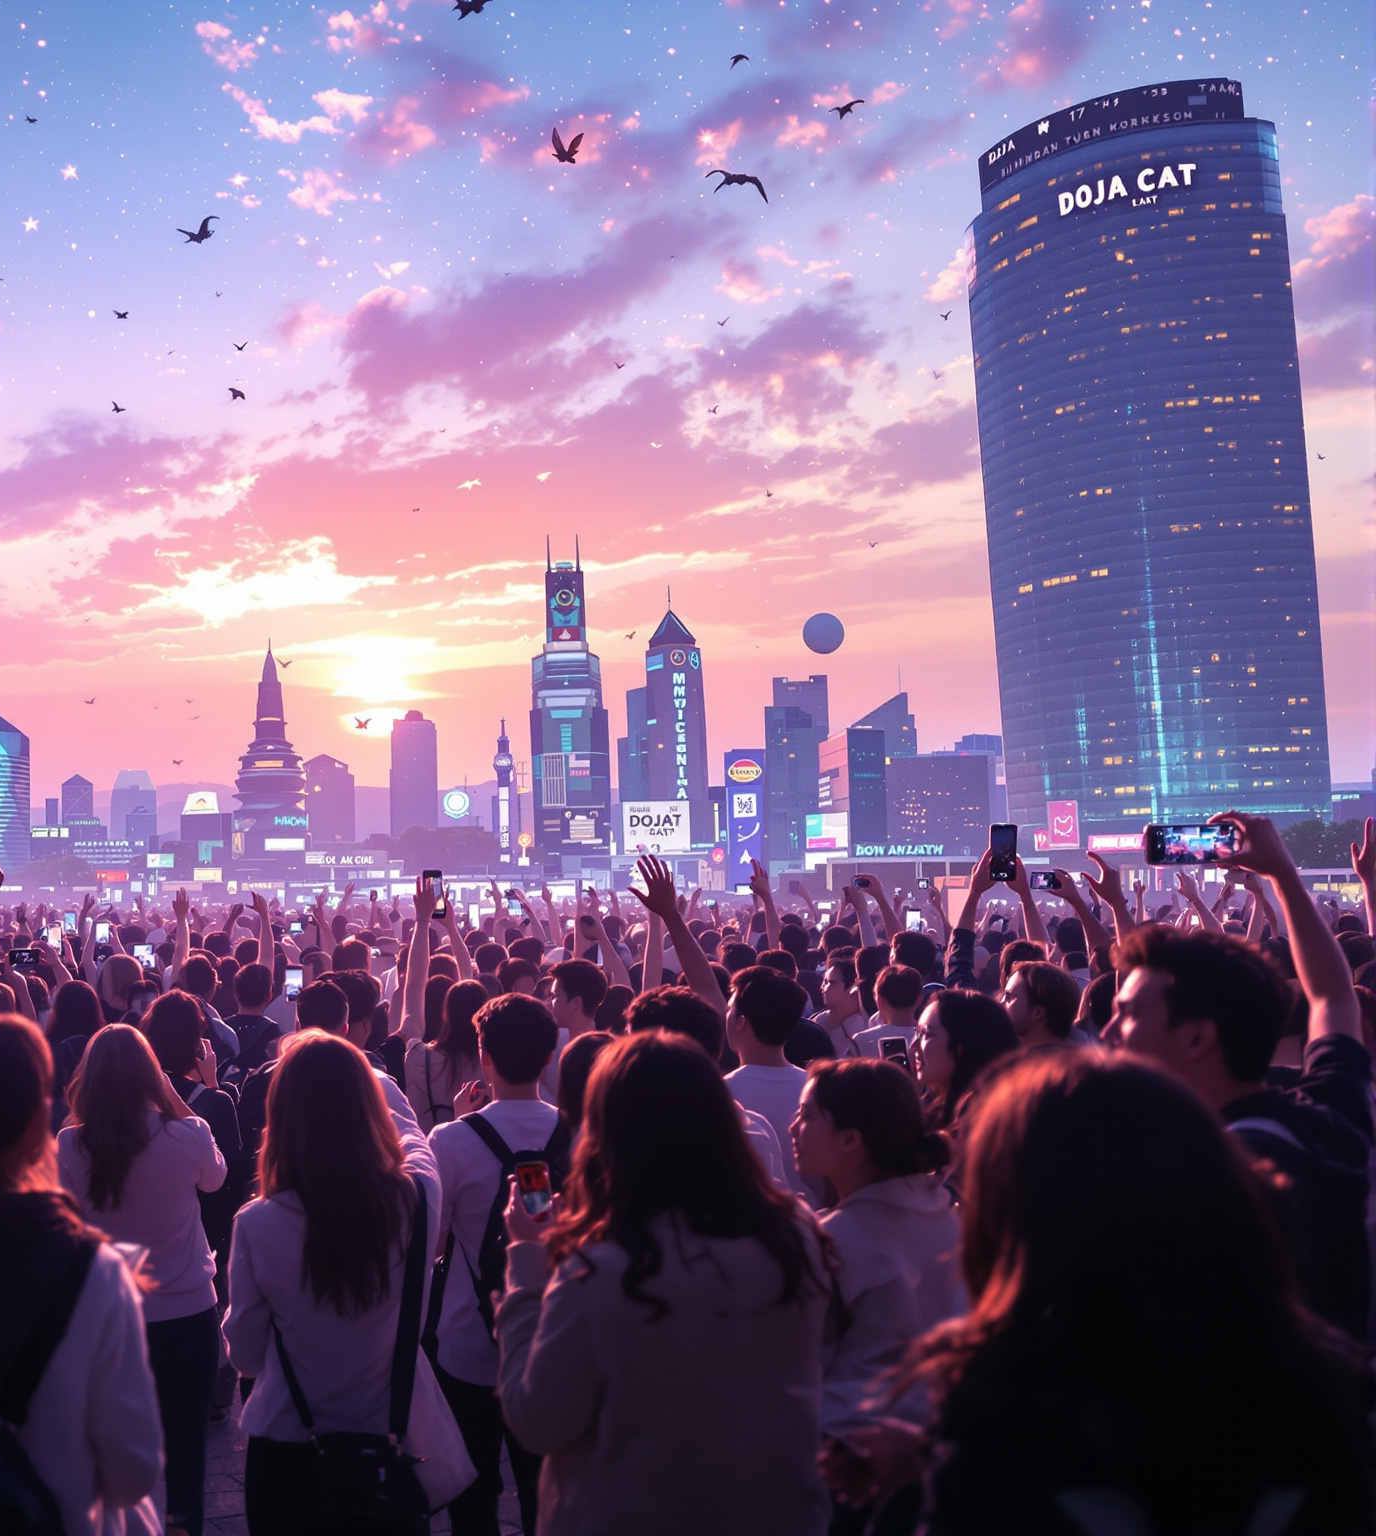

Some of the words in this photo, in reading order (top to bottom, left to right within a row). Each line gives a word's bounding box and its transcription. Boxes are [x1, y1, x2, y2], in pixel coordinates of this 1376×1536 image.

[1058, 174, 1128, 216] DOJA
[1137, 163, 1197, 192] CAT
[629, 814, 682, 828] DOJAT
